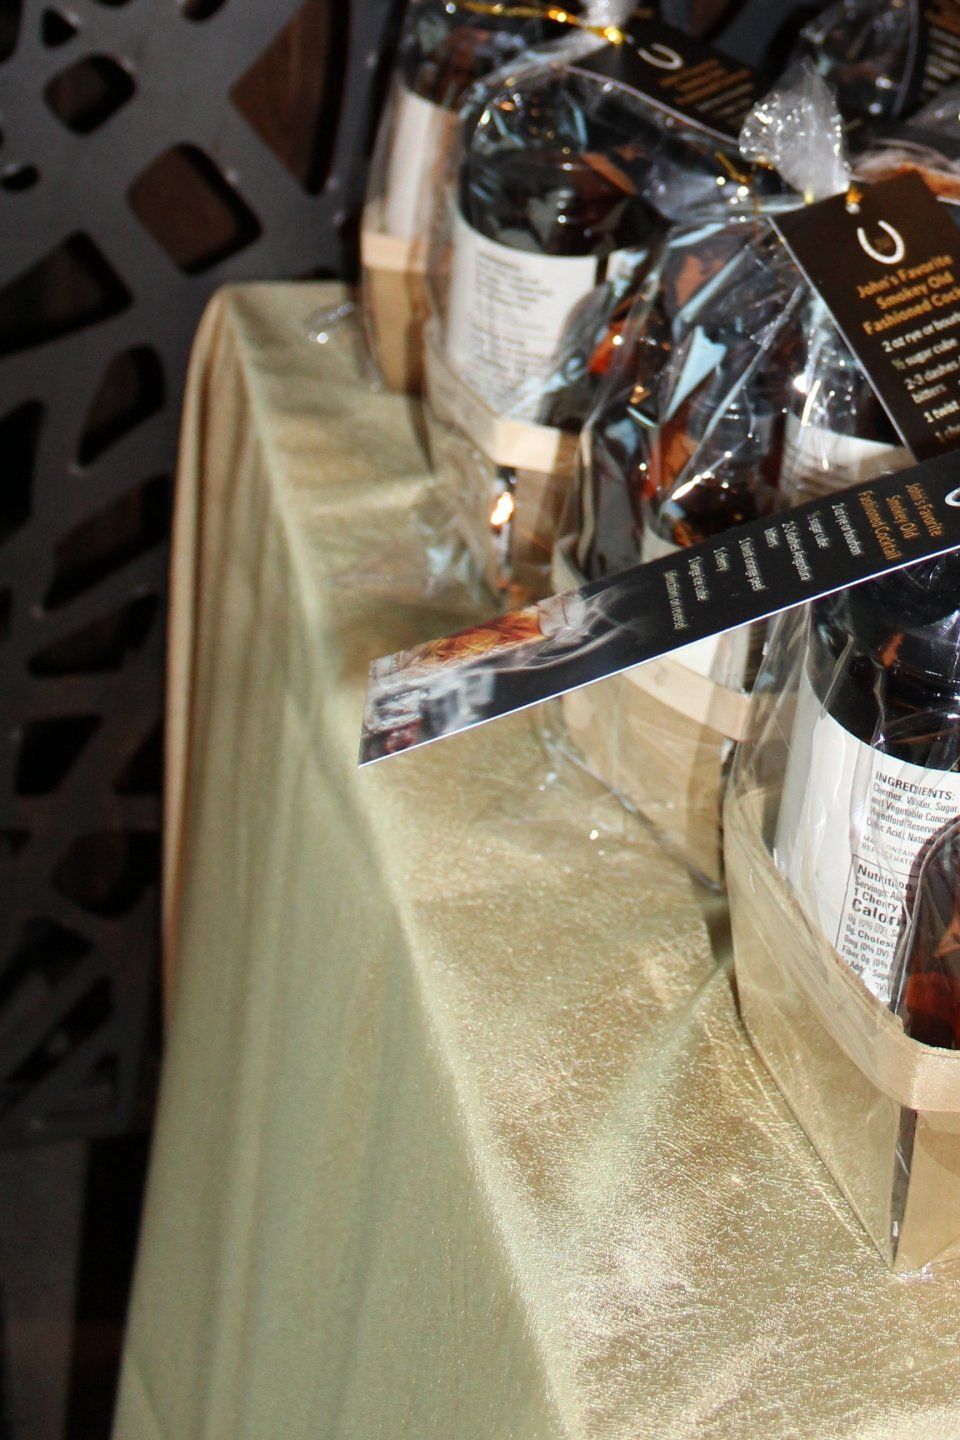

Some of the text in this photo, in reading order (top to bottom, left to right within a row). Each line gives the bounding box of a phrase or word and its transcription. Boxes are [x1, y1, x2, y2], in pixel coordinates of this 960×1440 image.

[857, 254, 953, 298] John's Favorite
[876, 271, 954, 309] Smokey Old
[862, 298, 932, 335] Fashioned
[880, 340, 892, 352] 2
[904, 330, 923, 344] rye
[921, 324, 935, 335] or
[904, 349, 934, 367] sugar
[931, 336, 958, 353] cube
[923, 359, 959, 379] dashes
[832, 501, 843, 509] 2
[886, 494, 920, 539] Smokey Old
[905, 482, 944, 537] John's Favorite
[835, 513, 847, 526] rye
[857, 489, 903, 560] Fashioned Cocktail
[764, 527, 779, 547] bitters
[808, 517, 823, 536] sugar
[816, 531, 829, 548] cube
[844, 529, 861, 555] bourbon
[712, 551, 729, 573] cherry
[740, 542, 753, 558] twist
[782, 520, 811, 581] 2-3 dashes Angostura
[688, 560, 702, 577] large
[742, 557, 757, 578] orange
[693, 575, 704, 586] ice
[695, 584, 707, 601] cube
[749, 575, 764, 592] peel
[876, 771, 956, 801] INGREDIENTS:
[935, 803, 960, 816] Sugar,
[858, 864, 912, 891] Nutrition
[852, 898, 906, 927] Calori
[862, 891, 898, 913] Cherry
[842, 945, 859, 959] Fiber
